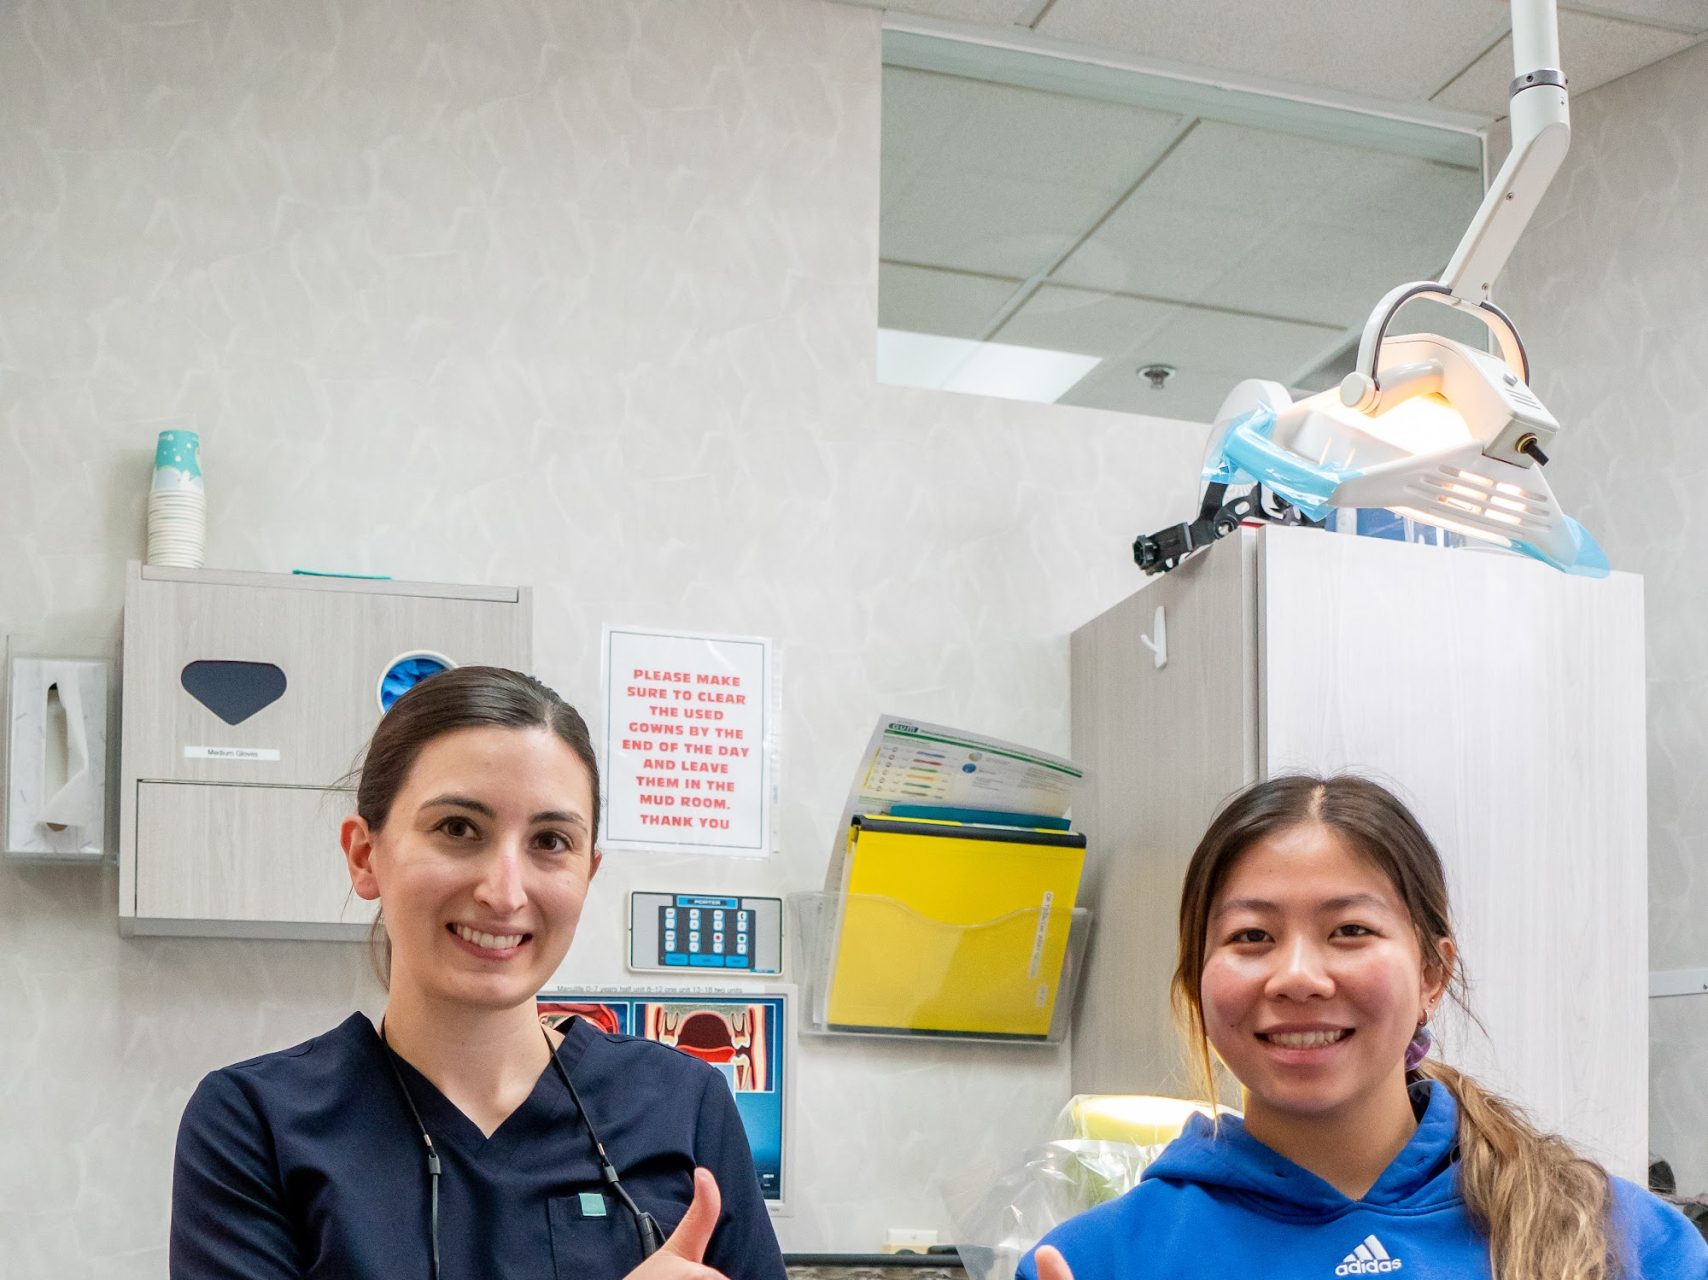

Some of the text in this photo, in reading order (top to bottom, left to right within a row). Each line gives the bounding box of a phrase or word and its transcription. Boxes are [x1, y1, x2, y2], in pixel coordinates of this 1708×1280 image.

[633, 669, 740, 687] PLEASE MAKE
[627, 686, 745, 704] SURE TO CLEAR
[649, 705, 724, 720] THE USED
[628, 721, 743, 740] GOWNS BY THE
[621, 738, 748, 757] END OF THE DAY
[643, 758, 728, 774] AND LEAVE
[636, 775, 735, 792] THEM IN THE
[639, 794, 730, 809] MUD ROOM.
[641, 814, 730, 830] THANK YOU
[1335, 1258, 1402, 1277] adidas
